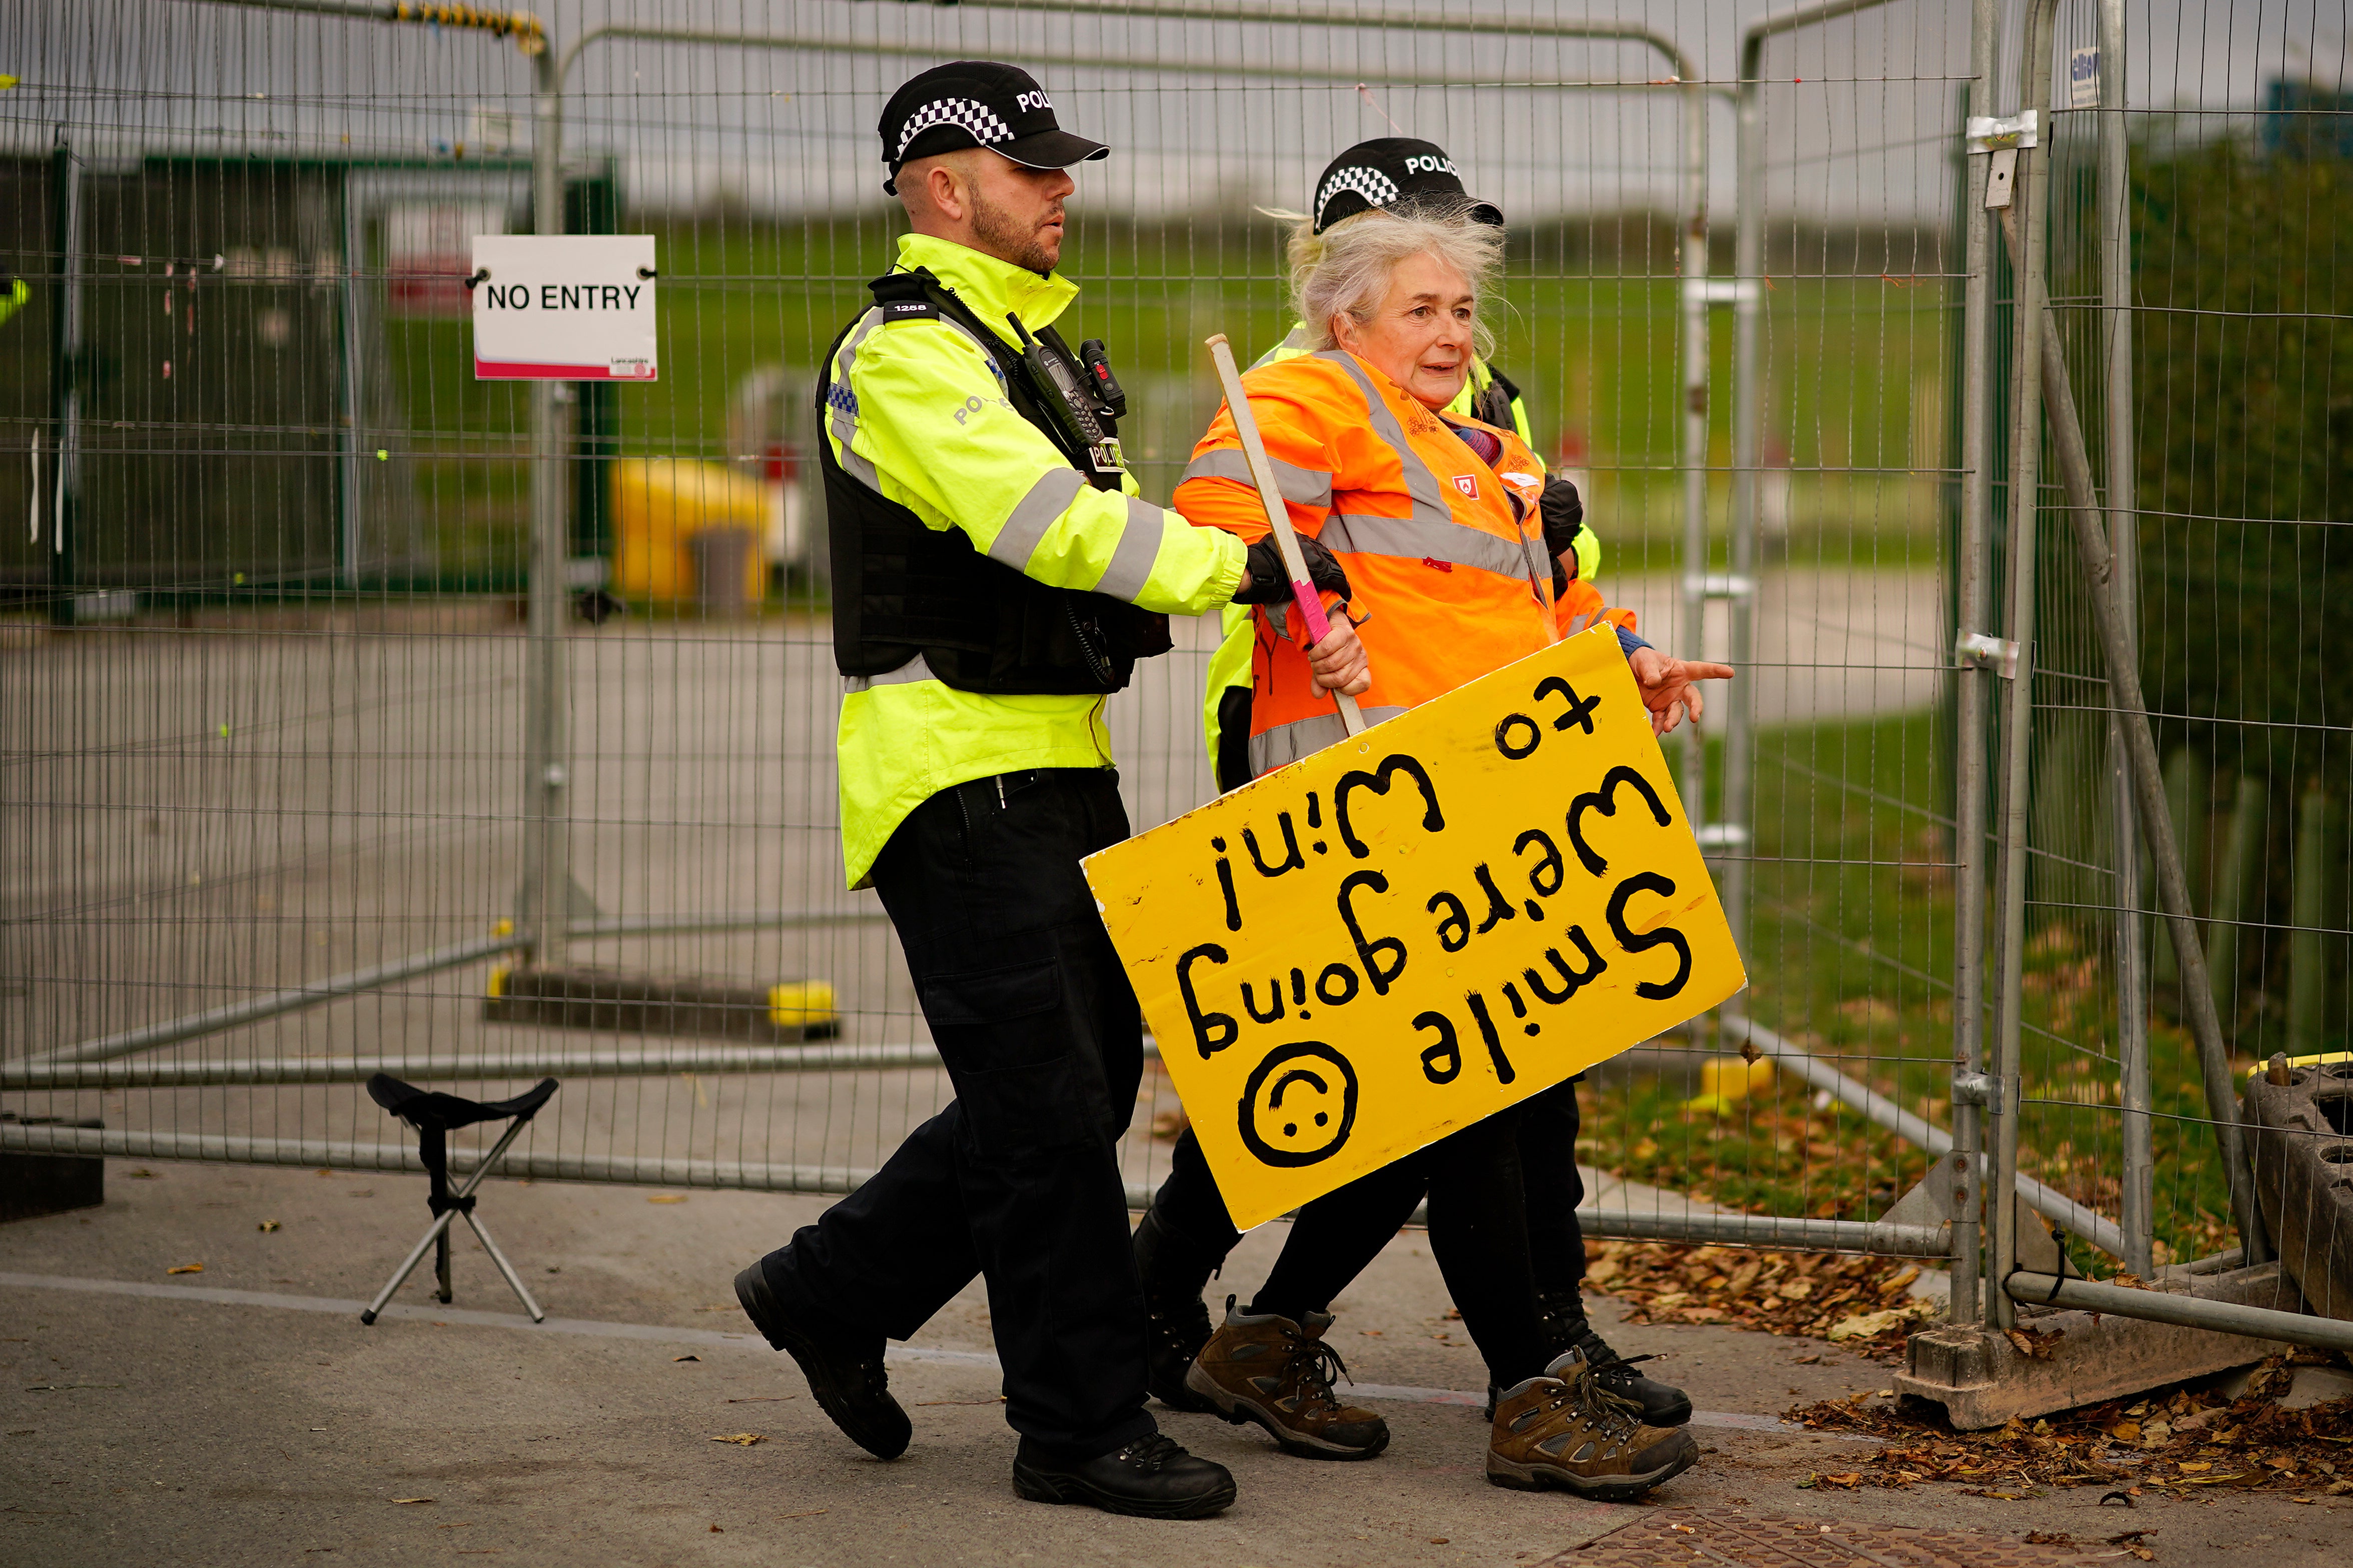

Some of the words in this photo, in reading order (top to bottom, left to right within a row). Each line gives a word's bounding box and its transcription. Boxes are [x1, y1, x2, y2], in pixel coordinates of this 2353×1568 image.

[1016, 90, 1053, 113] POLI
[1405, 155, 1462, 182] POLIC
[488, 285, 529, 310] NO
[541, 285, 641, 310] ENTRY
[1495, 677, 1601, 760] to
[1211, 754, 1445, 931] Win!
[1426, 766, 1671, 952] We're
[1176, 870, 1407, 1060] going
[1411, 872, 1692, 1084] Smile
